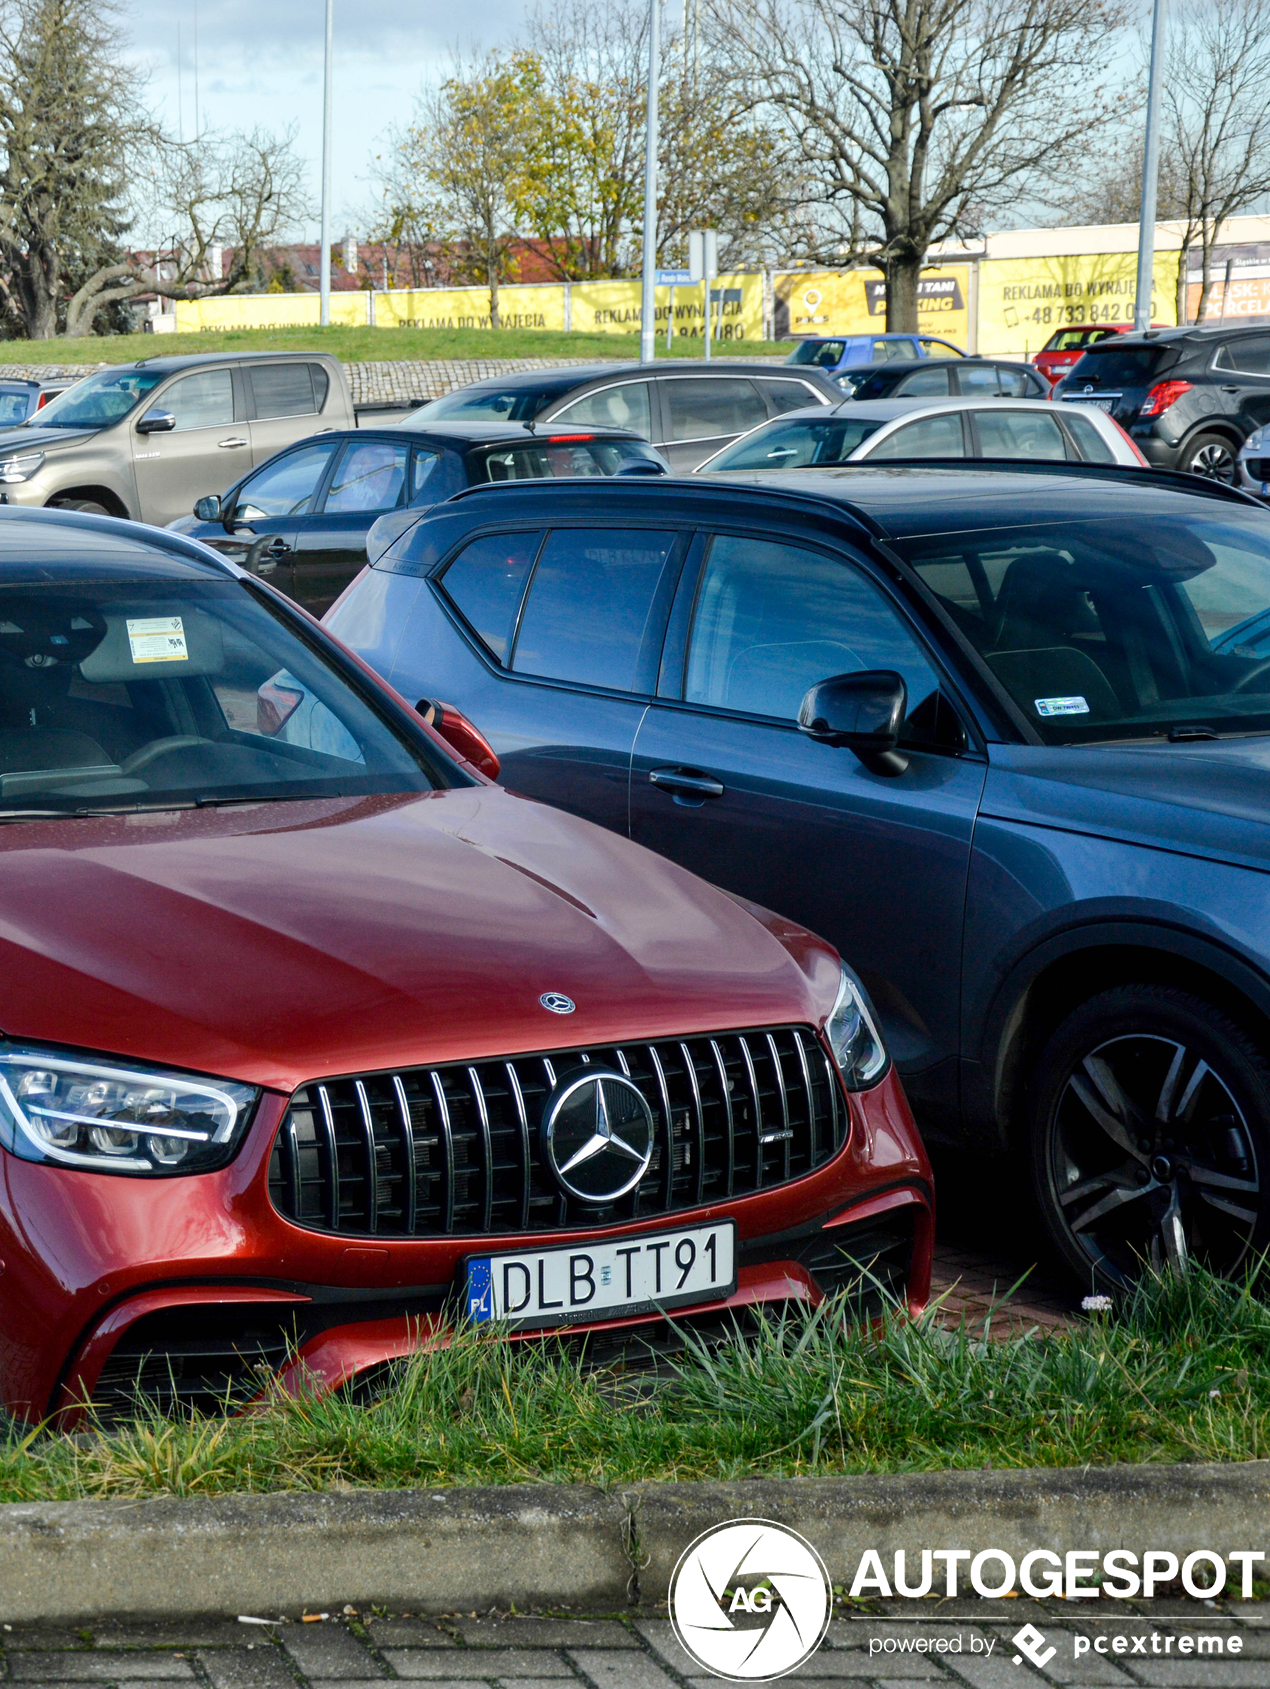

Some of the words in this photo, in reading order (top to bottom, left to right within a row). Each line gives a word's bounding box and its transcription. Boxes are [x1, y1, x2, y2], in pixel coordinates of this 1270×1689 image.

[924, 281, 956, 293] TANI
[1003, 283, 1061, 300] REKLAMA
[1065, 282, 1083, 297] DO
[1024, 306, 1052, 324] +48
[1057, 304, 1085, 323] 733
[1090, 303, 1120, 321] 842
[1125, 301, 1157, 320] 00
[502, 1253, 597, 1314] DLB
[616, 1232, 718, 1299] TT91
[470, 1298, 489, 1312] PL
